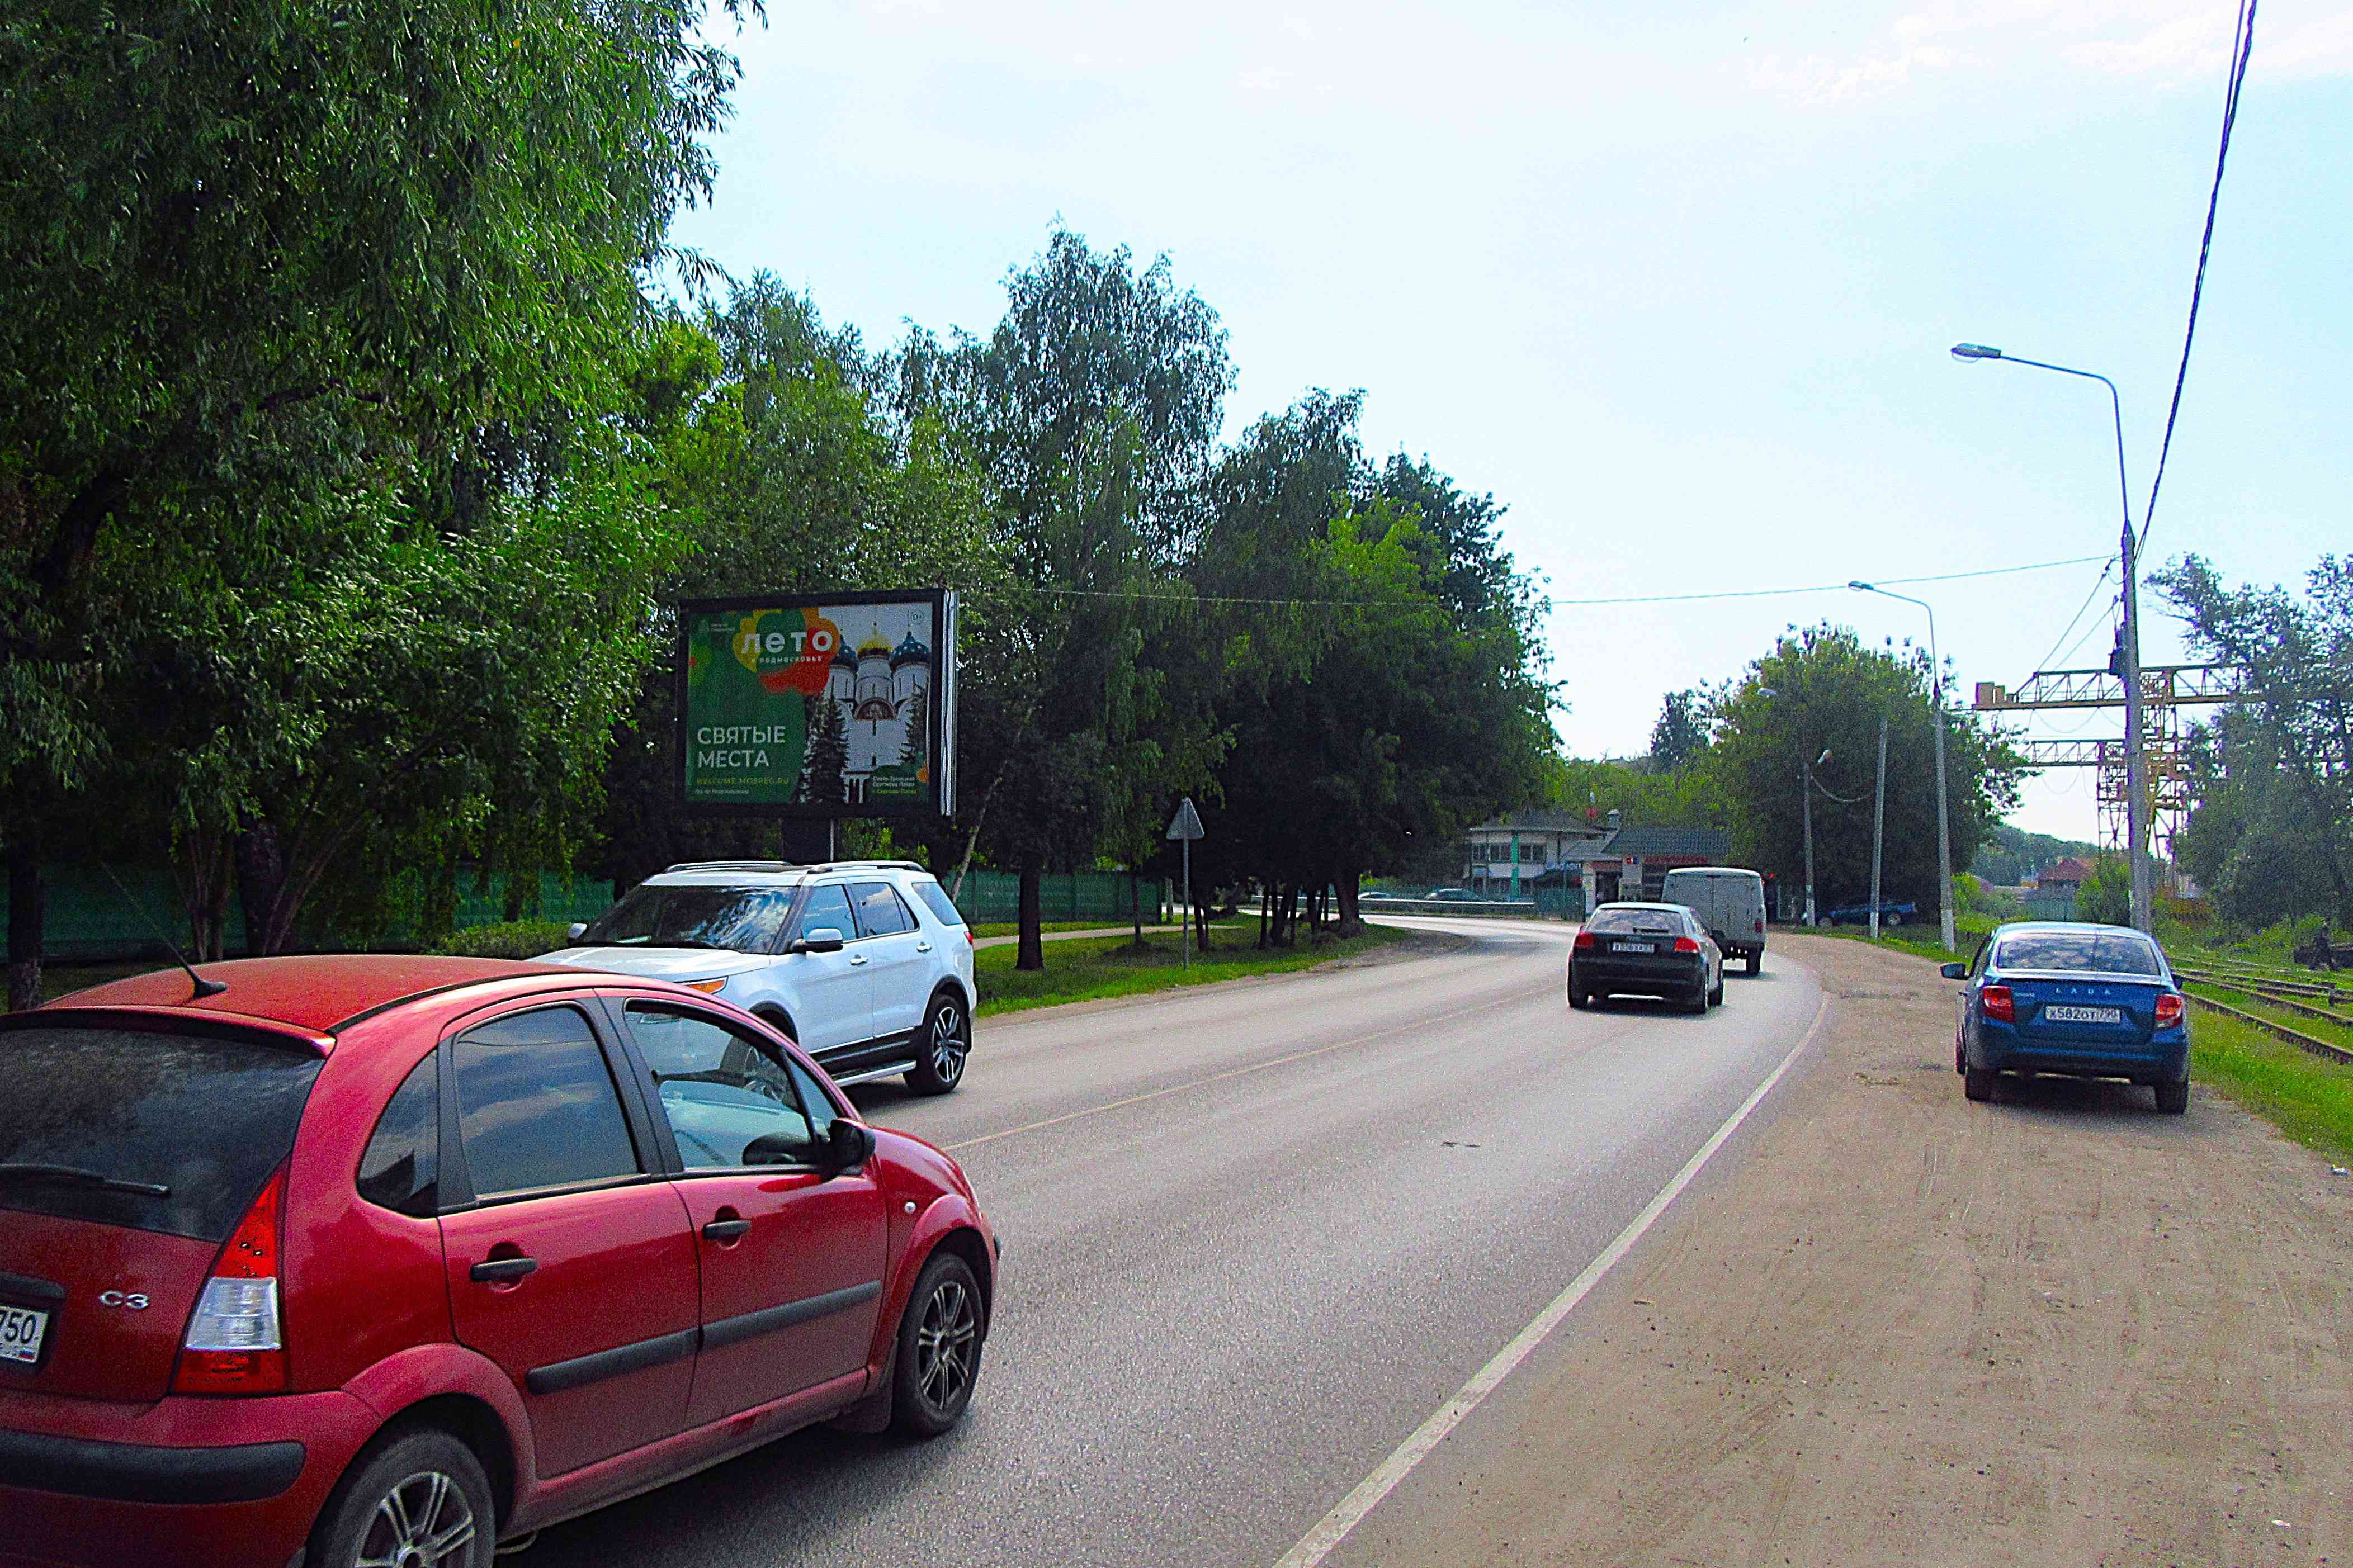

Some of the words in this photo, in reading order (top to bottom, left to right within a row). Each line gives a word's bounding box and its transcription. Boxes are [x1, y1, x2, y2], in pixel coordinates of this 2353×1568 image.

[697, 726, 786, 745] СВЯТЫЕ
[698, 750, 769, 768] МЕСТА
[100, 1290, 150, 1309] C3
